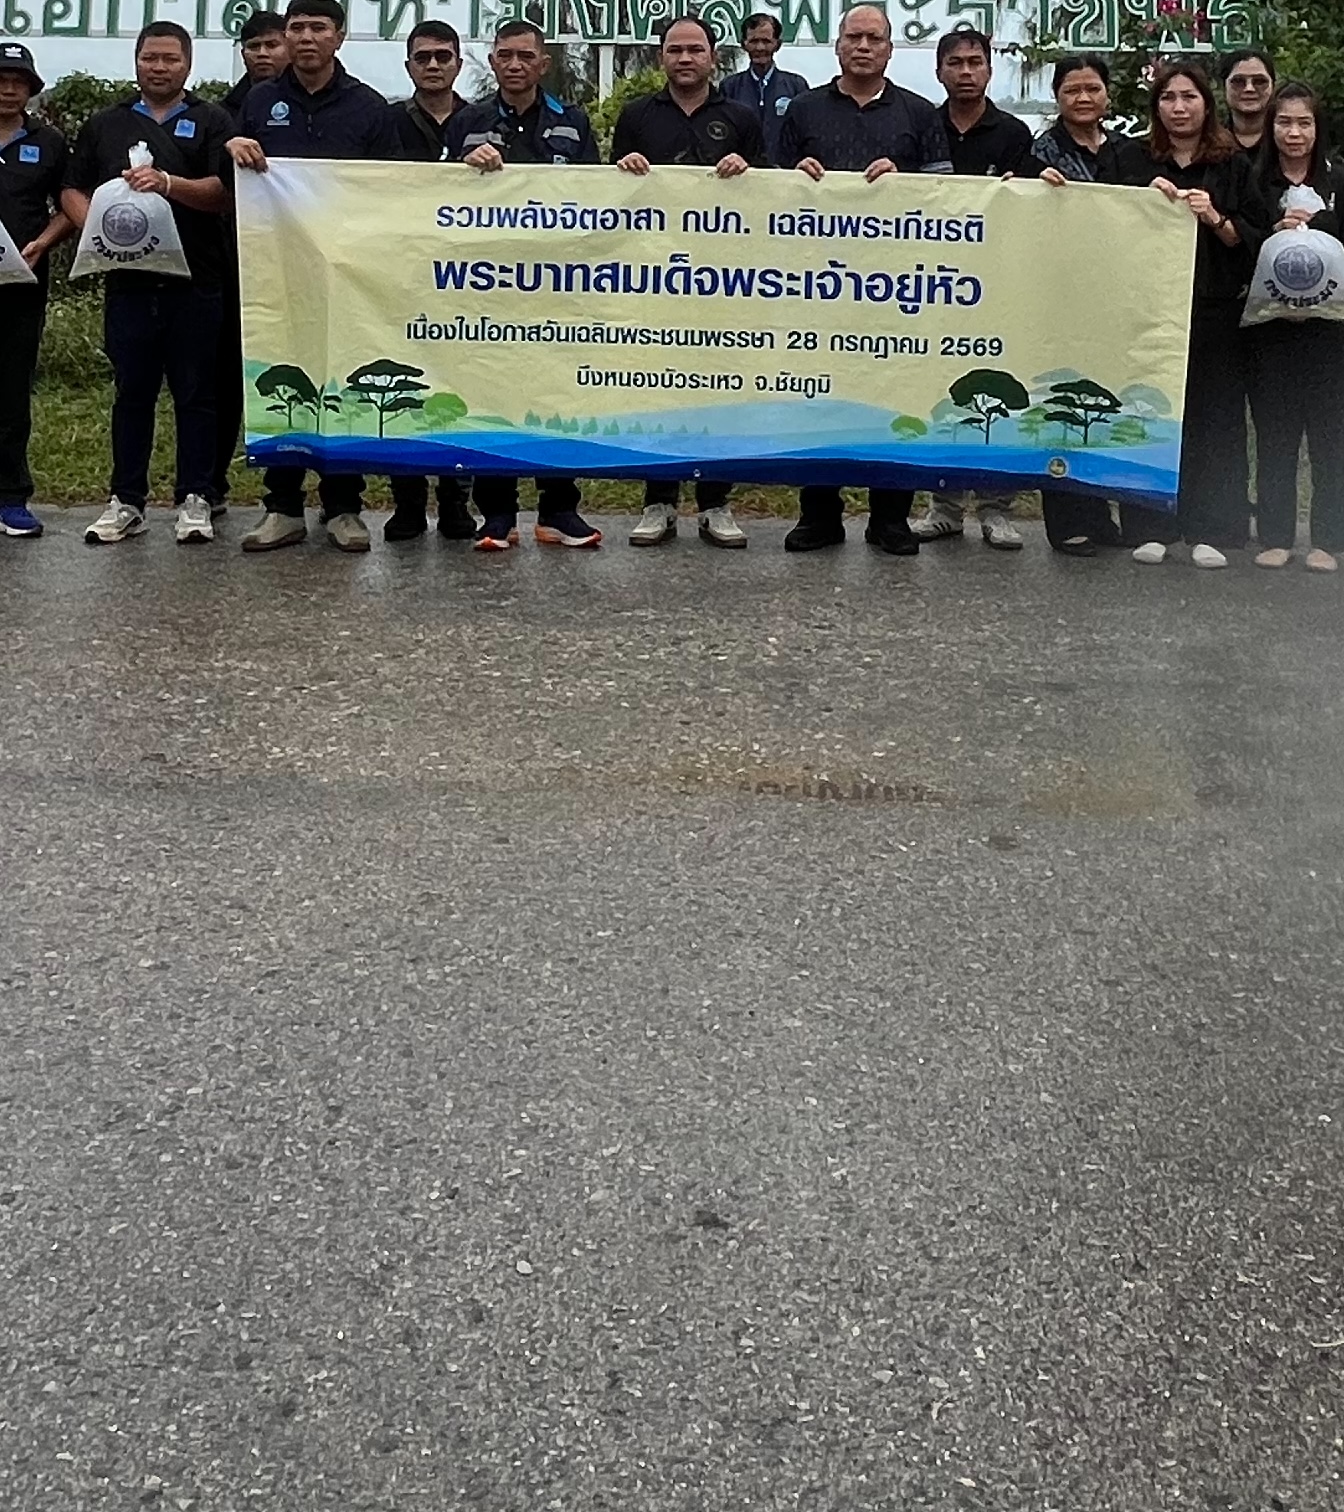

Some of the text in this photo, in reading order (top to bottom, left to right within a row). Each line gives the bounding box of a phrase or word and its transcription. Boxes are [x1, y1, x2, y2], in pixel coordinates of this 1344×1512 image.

[436, 199, 984, 243] รวมพลังจิตอาสา กปภ. เฉลิมพระเกียรติ
[433, 253, 983, 315] พระบาทสมเด็จพระเจ้าอยู่หัว
[406, 313, 1004, 359] เนื่องในโอกาสวันเฉลิมพระชนมพรรษา 28 กรกฎาคม 2569
[576, 364, 832, 399] บึงหนองบัวระเหว จ.ชัยภูมิ
